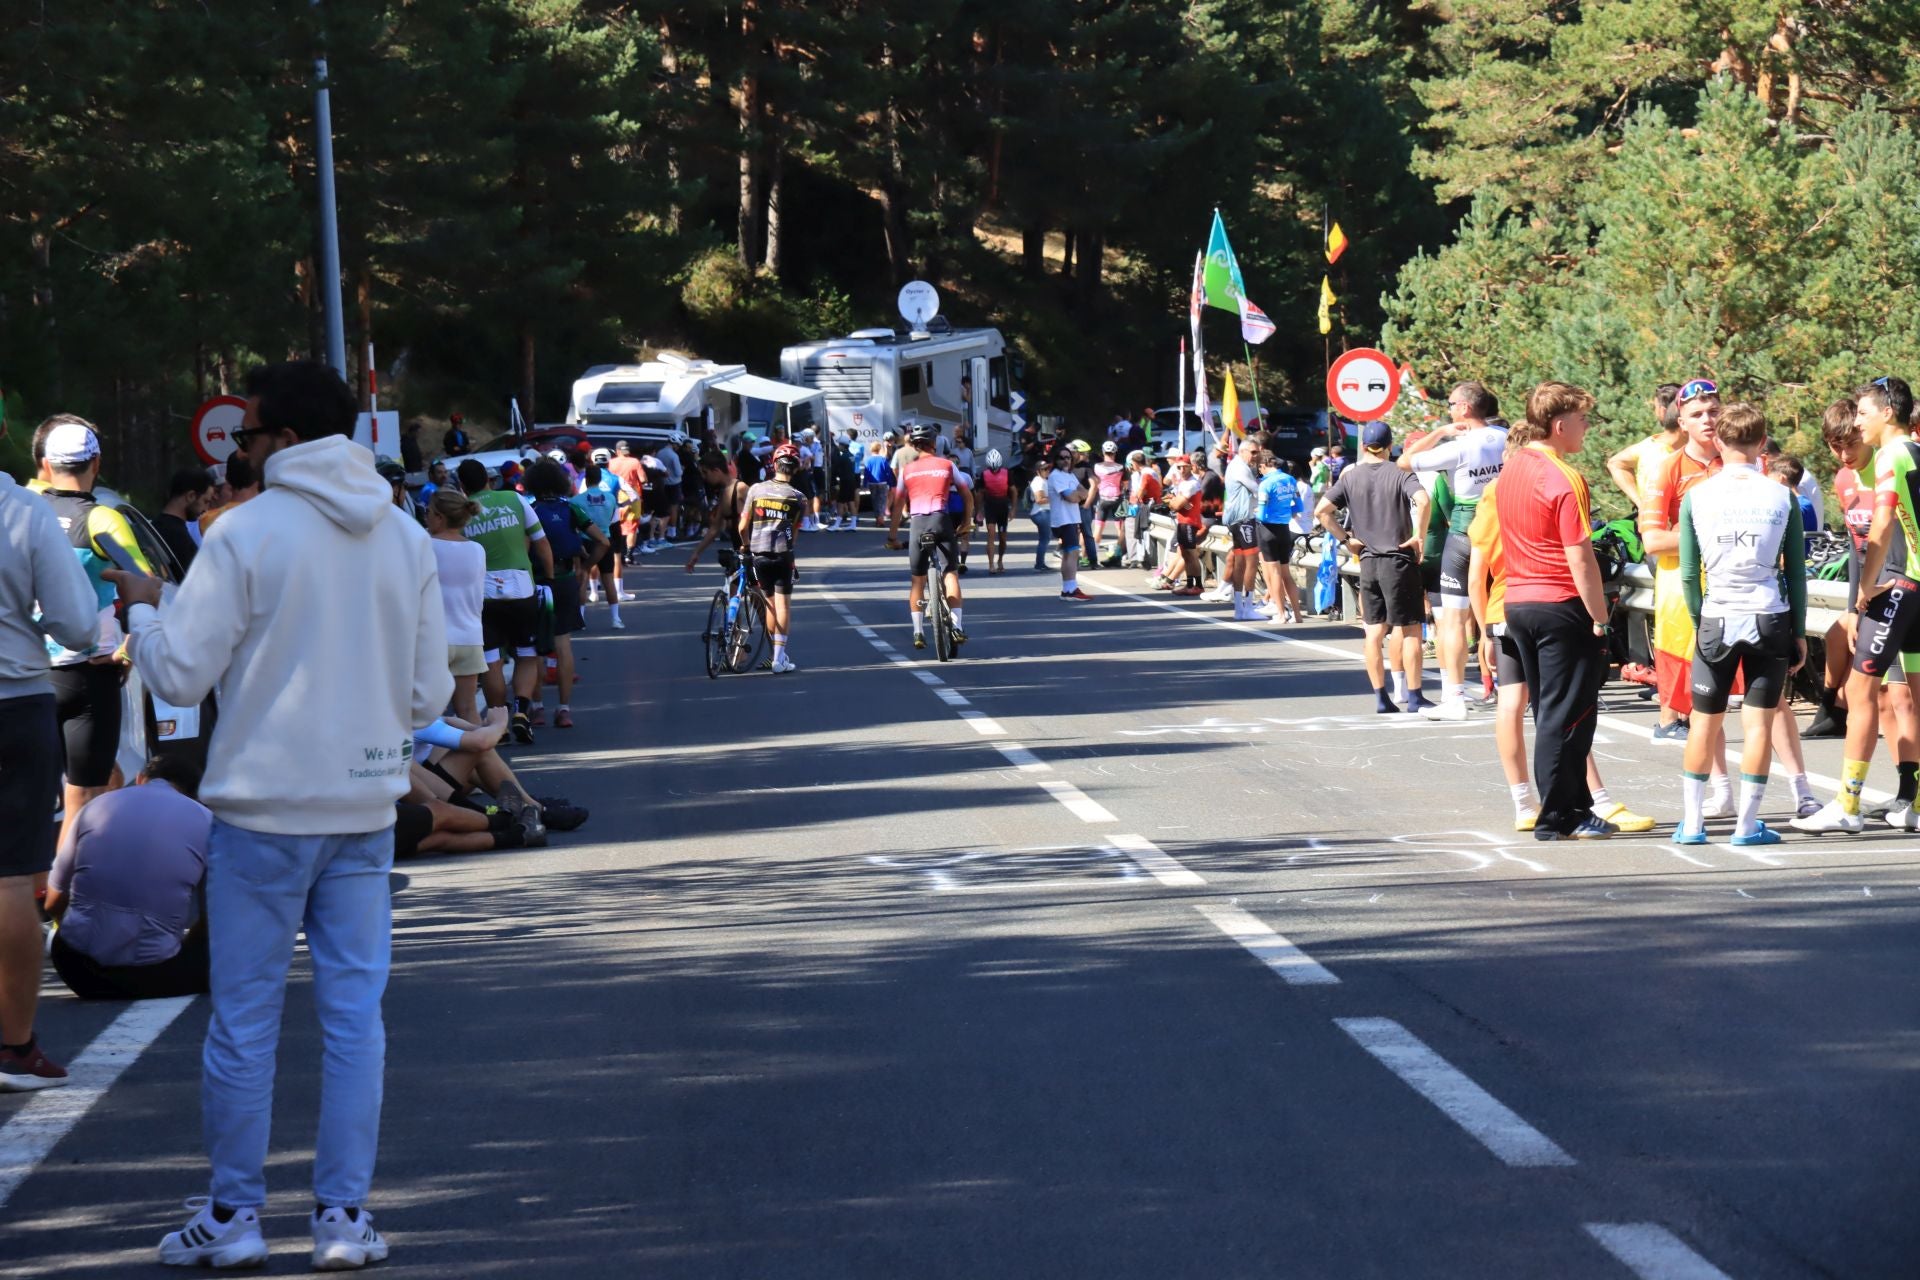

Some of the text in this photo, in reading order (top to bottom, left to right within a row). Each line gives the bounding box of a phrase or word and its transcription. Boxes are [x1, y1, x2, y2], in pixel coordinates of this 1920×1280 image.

[838, 429, 880, 438] TDOR
[765, 509, 788, 519] VISMA
[463, 514, 520, 538] NAVAFRIA
[1870, 589, 1904, 655] CALLEJO
[364, 747, 384, 760] We
